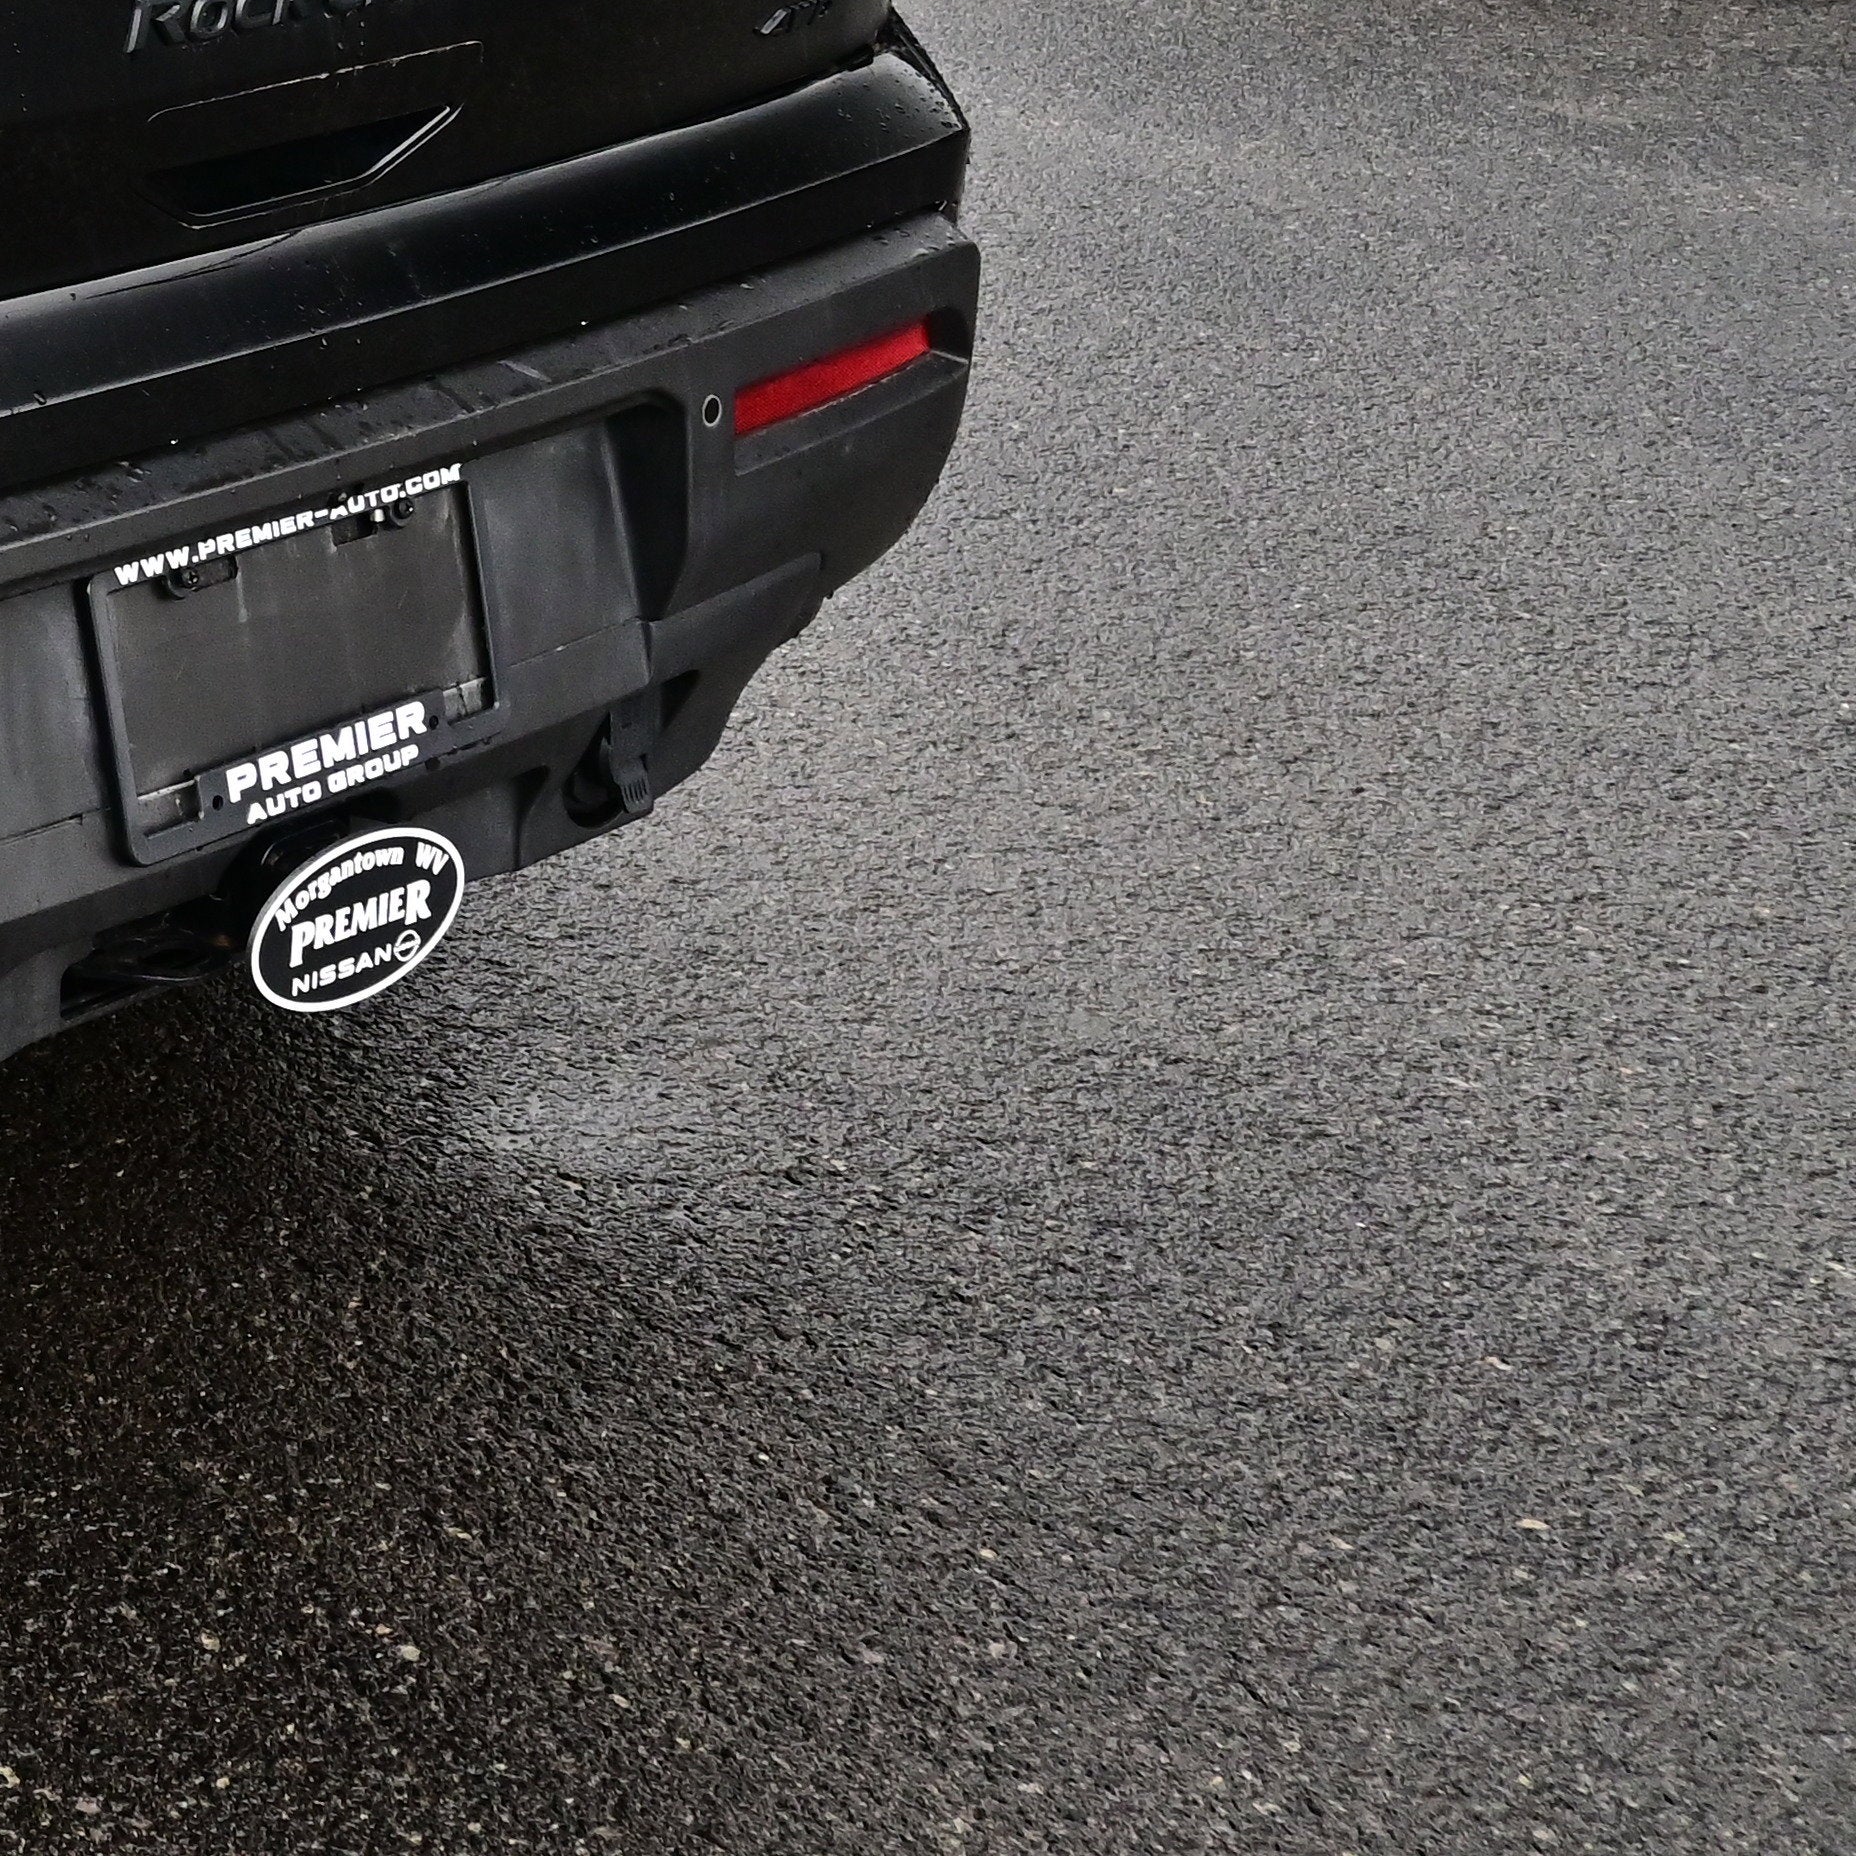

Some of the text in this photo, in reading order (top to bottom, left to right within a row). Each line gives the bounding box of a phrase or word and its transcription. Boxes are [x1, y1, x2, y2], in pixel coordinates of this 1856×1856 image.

[114, 463, 462, 586] WWW.PREMIER-AUTO.COM
[226, 701, 427, 803] PREMIER
[247, 744, 419, 825] AUTO GROUP
[275, 841, 450, 932] Morgantown WV
[289, 879, 432, 968] PREMIER
[291, 943, 392, 996] NISSAN
